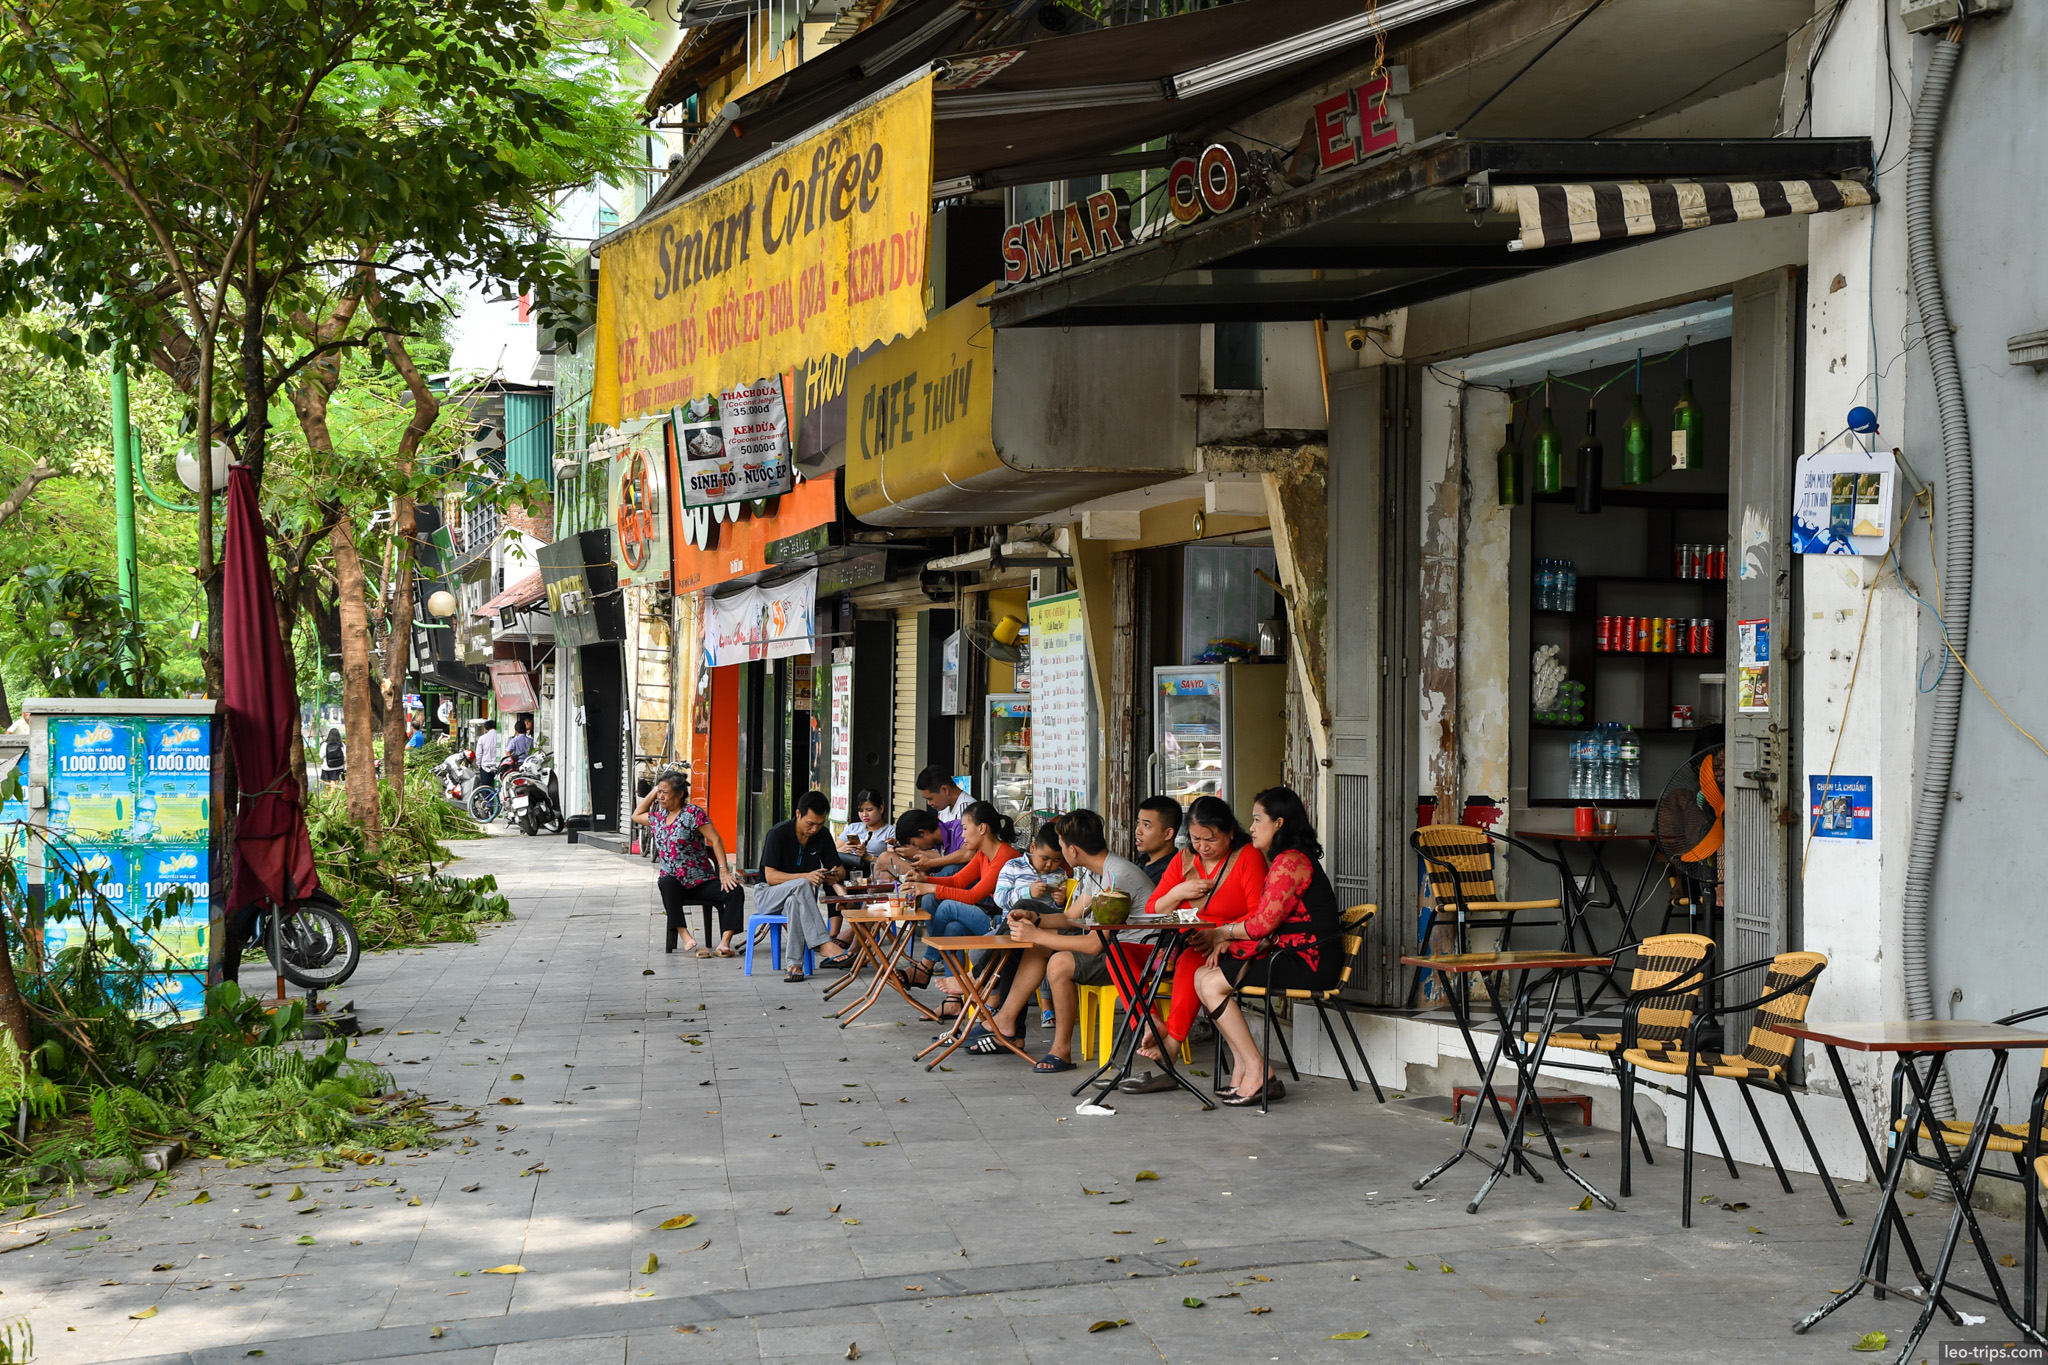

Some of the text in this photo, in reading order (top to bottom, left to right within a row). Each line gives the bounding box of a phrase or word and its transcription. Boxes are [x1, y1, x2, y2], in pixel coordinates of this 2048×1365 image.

[1002, 74, 1400, 284] SMAR CO EE
[654, 137, 884, 301] Smart Coffee
[647, 322, 678, 377] SINH
[680, 293, 698, 366] TỐ
[742, 277, 765, 343] ÉP
[769, 275, 795, 337] HOA
[798, 236, 827, 334] QUẢ
[847, 238, 886, 307] KEM
[653, 379, 677, 406] THANH
[720, 386, 777, 403] THẠCH DỪA
[725, 398, 758, 410] (Coconut
[733, 404, 770, 417] 35.000đ
[860, 370, 918, 460] CAFE
[733, 421, 776, 436] KEM DỪA
[728, 434, 759, 446] (Coconut
[740, 442, 776, 455] 50.000đ
[690, 474, 719, 491] SINH
[719, 465, 736, 488] TỐ
[744, 465, 775, 485] NƯỚC
[775, 462, 787, 479] ÉP
[1181, 679, 1204, 689] SANYO
[60, 755, 127, 772] 1.000.000
